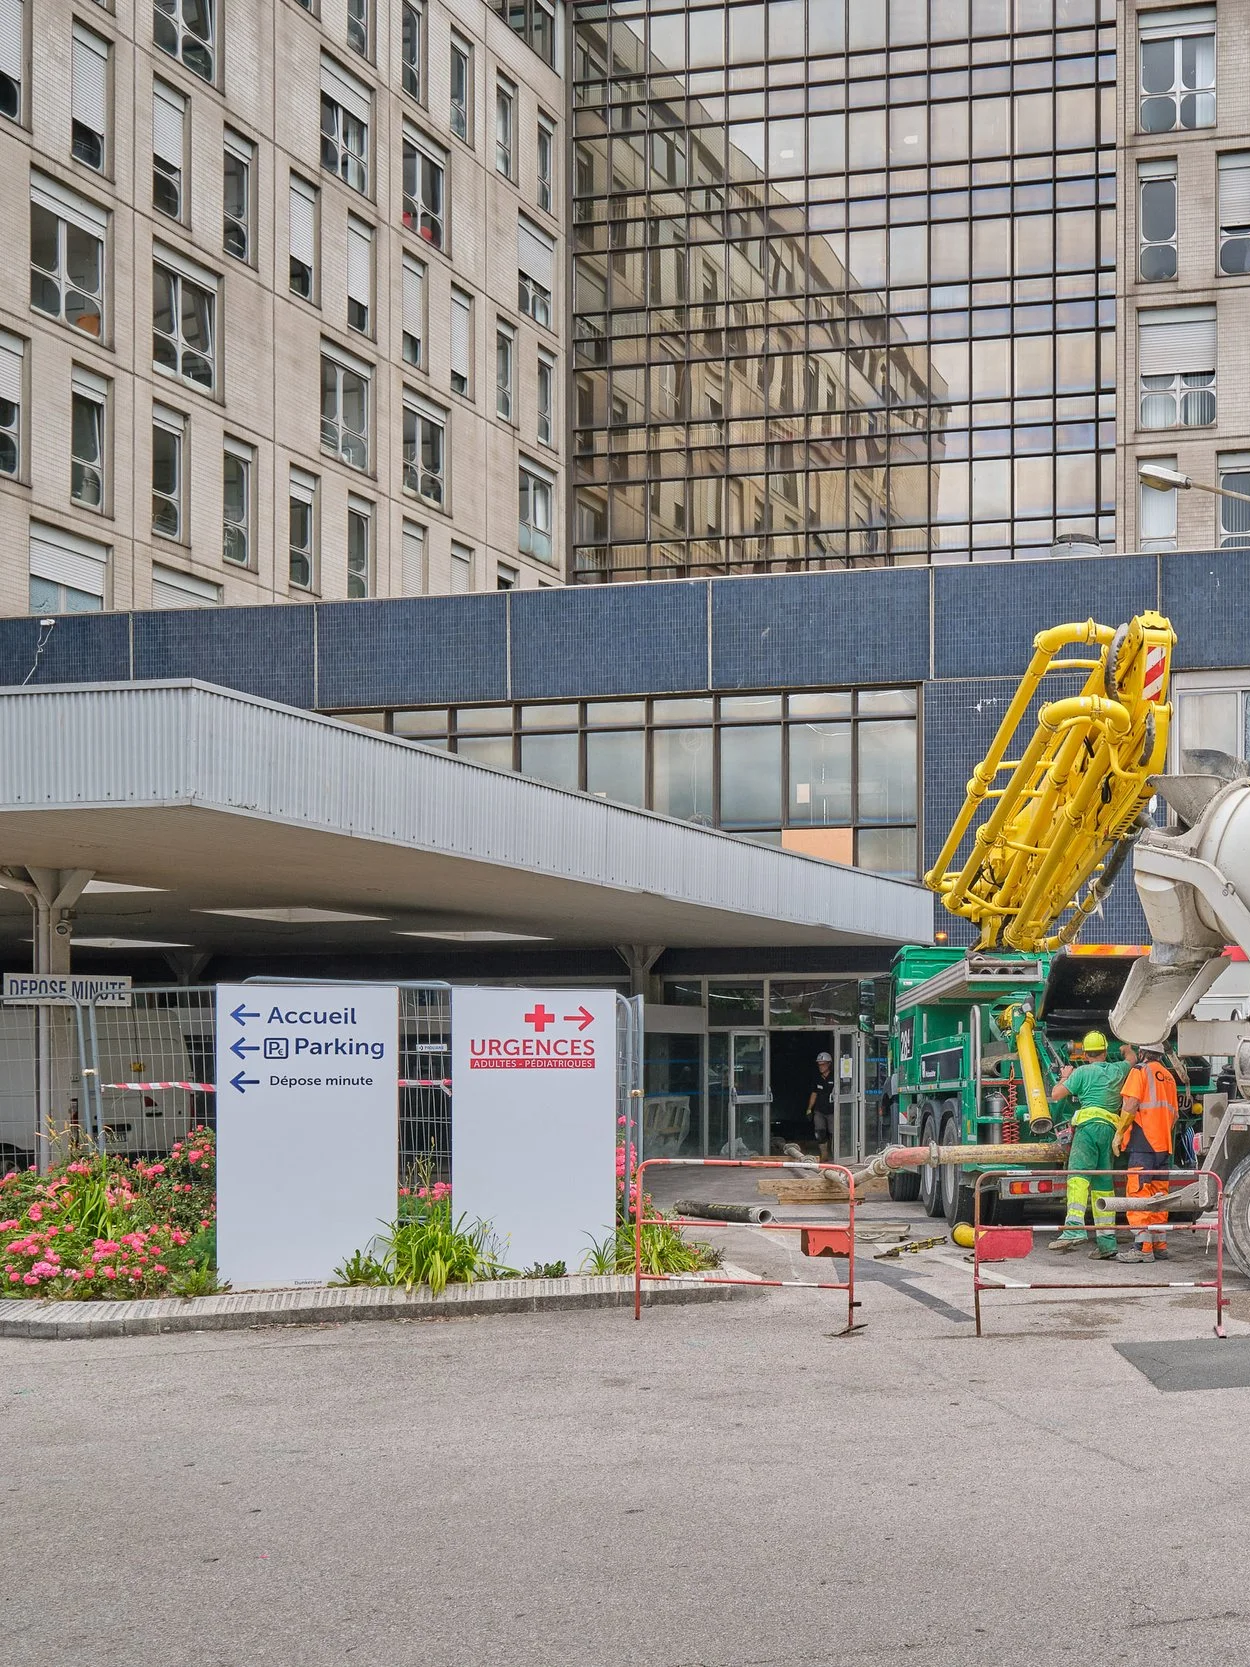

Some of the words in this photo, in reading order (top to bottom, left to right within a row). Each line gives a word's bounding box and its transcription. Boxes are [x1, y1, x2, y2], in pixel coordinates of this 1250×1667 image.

[72, 981, 126, 1001] MINUTE
[267, 1006, 357, 1025] Accueil
[295, 1037, 385, 1060] Parking
[470, 1039, 595, 1056] URGENCES
[473, 1059, 517, 1068] ADULTES
[524, 1059, 593, 1069] PÉDIATRIQUES
[269, 1075, 322, 1088] Dépose
[325, 1075, 374, 1086] minute
